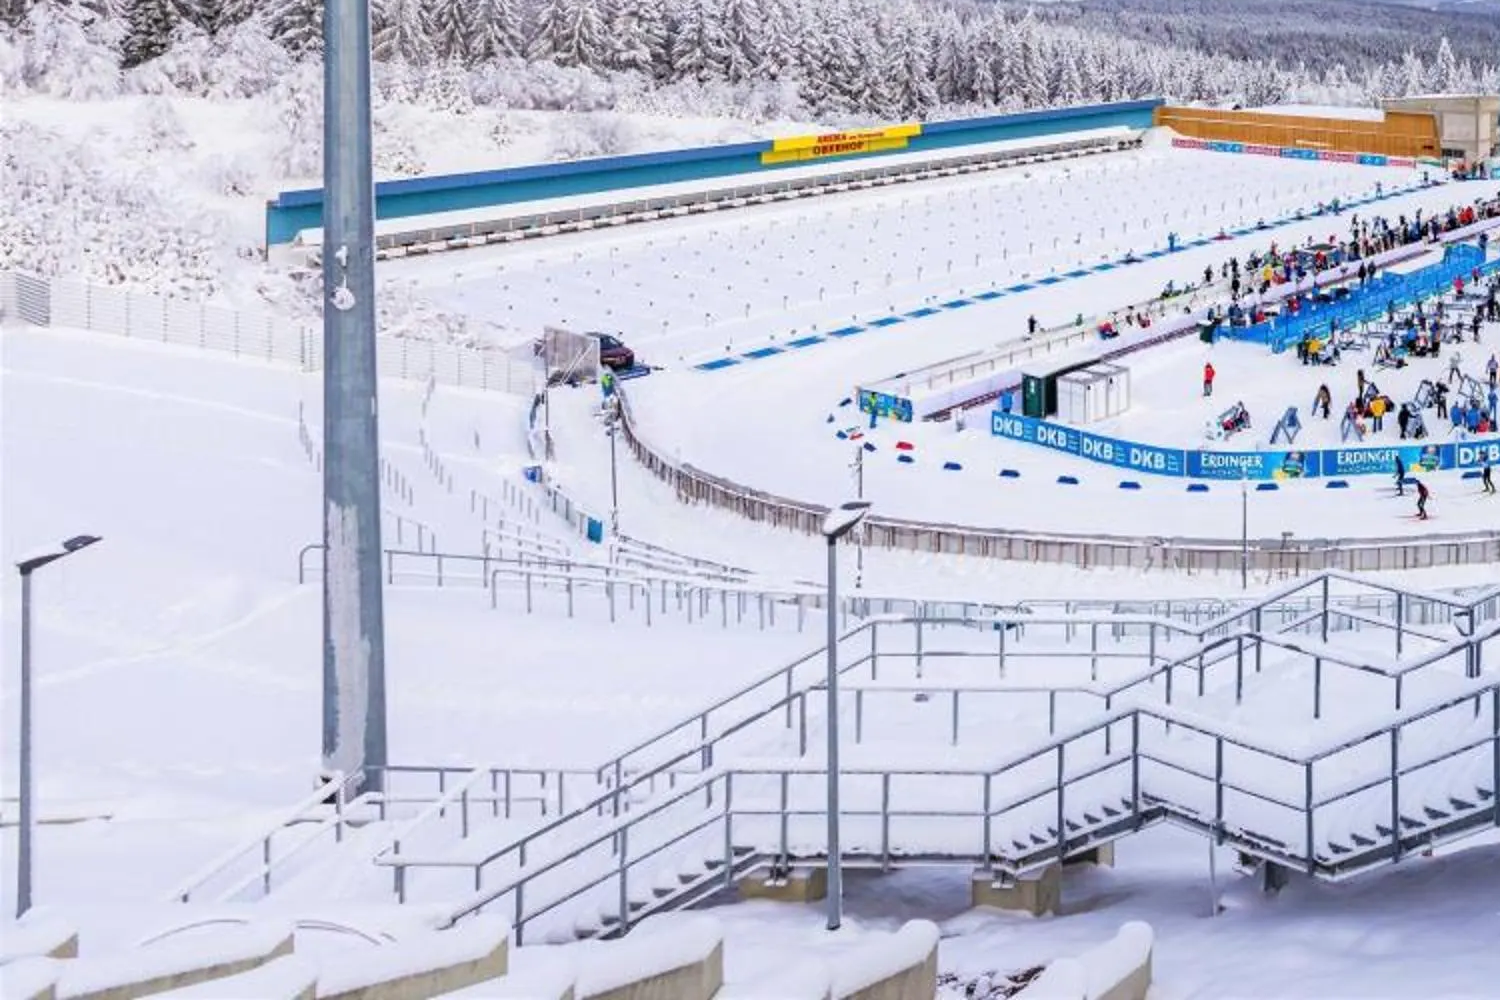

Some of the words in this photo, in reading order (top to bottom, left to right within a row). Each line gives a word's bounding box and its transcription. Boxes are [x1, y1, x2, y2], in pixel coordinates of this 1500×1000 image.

[993, 415, 1024, 437] DKB
[1037, 425, 1067, 447] DKB
[1083, 437, 1113, 459] DKB
[1130, 448, 1165, 469] DKB
[1201, 453, 1263, 468] ERDINGER
